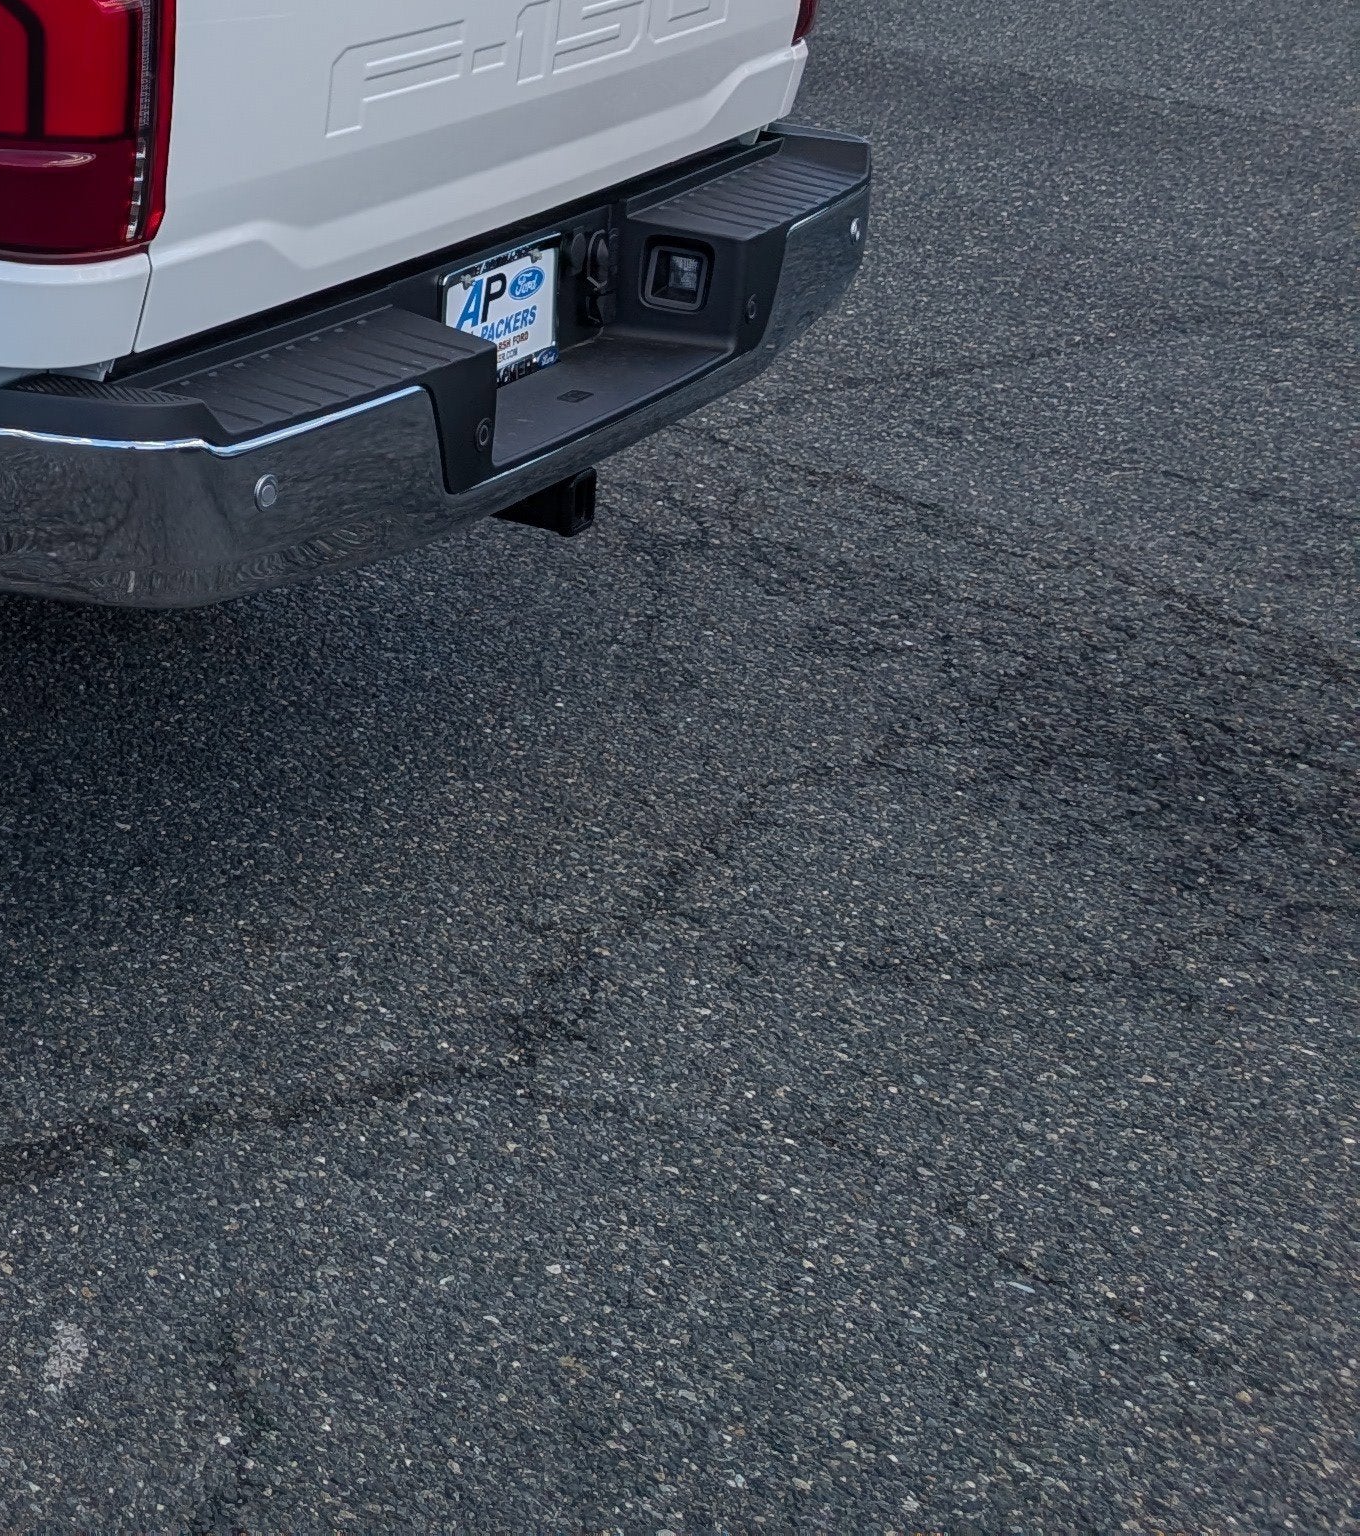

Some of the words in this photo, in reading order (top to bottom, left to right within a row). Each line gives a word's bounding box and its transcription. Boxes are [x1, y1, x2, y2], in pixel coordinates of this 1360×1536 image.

[514, 272, 539, 296] Ford
[480, 305, 538, 341] PACKERS
[513, 330, 529, 346] FORD
